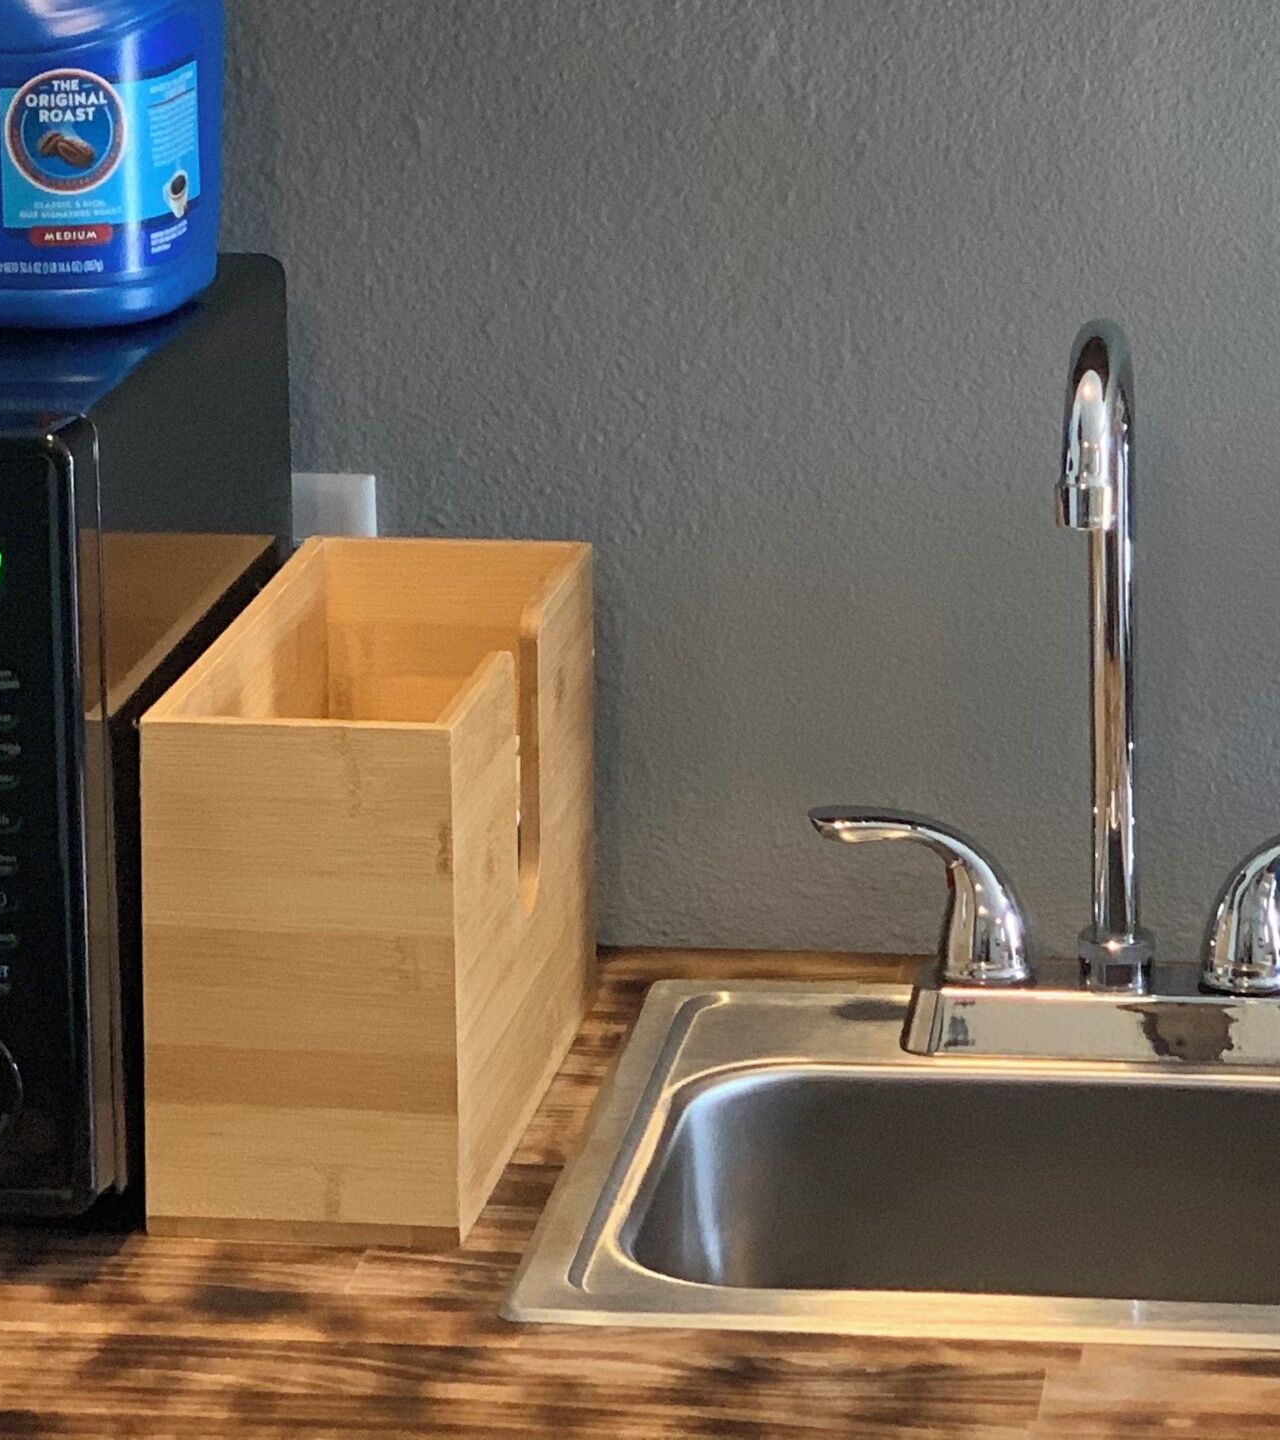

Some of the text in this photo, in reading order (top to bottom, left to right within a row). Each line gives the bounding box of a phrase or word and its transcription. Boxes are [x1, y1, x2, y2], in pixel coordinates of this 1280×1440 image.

[51, 79, 80, 92] THE
[25, 90, 108, 108] ORIGINAL
[38, 107, 96, 123] ROAST
[44, 231, 97, 241] MEDIUM
